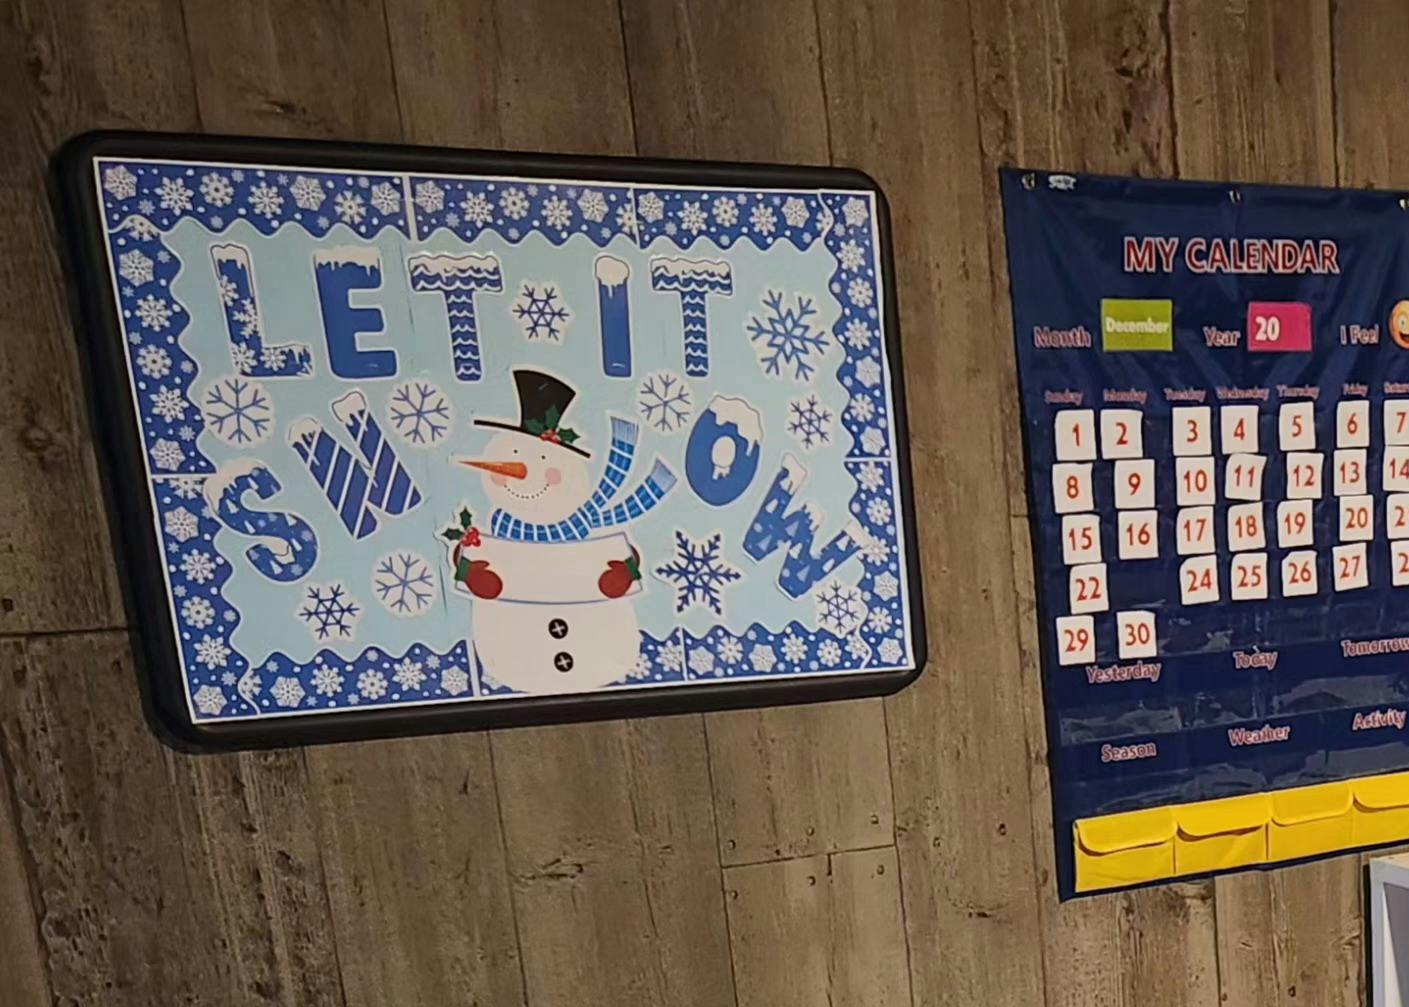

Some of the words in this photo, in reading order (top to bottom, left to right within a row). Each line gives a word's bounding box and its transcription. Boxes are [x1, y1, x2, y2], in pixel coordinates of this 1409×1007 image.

[1123, 236, 1179, 273] MY
[1184, 238, 1341, 275] CALENDAR
[210, 243, 503, 383] LET
[594, 254, 735, 381] IT
[1105, 316, 1170, 335] December
[1254, 316, 1281, 341] 20
[1033, 326, 1092, 349] Month
[1202, 326, 1241, 348] Year
[1350, 324, 1380, 345] Feel
[1072, 423, 1081, 447] 1
[1115, 422, 1129, 446] 2
[1186, 420, 1199, 443] 3
[1232, 417, 1246, 441] 4
[1291, 414, 1303, 437] 5
[1346, 412, 1359, 435] 6
[1395, 411, 1408, 434] 7
[1066, 475, 1080, 500] 8
[1127, 472, 1141, 496] 9
[1183, 470, 1208, 493] 10
[1234, 465, 1256, 489] 11
[1292, 464, 1316, 487] 12
[1338, 461, 1361, 484] 13
[1068, 527, 1093, 552] 15
[1125, 522, 1151, 547] 16
[1182, 518, 1207, 543] 17
[1234, 516, 1258, 540] 18
[1283, 512, 1307, 536] 19
[1345, 506, 1369, 530] 20
[1075, 576, 1102, 602] 22
[1186, 568, 1212, 593] 24
[1237, 563, 1262, 589] 25
[1287, 560, 1312, 585] 26
[1338, 555, 1362, 580] 27
[1063, 627, 1090, 653] 29
[1124, 622, 1150, 647] 30
[1086, 660, 1162, 685] Yesterday
[1232, 650, 1279, 671] Today
[1100, 741, 1157, 763] Season
[1228, 724, 1291, 747] Weather
[1352, 708, 1407, 731] Activity
